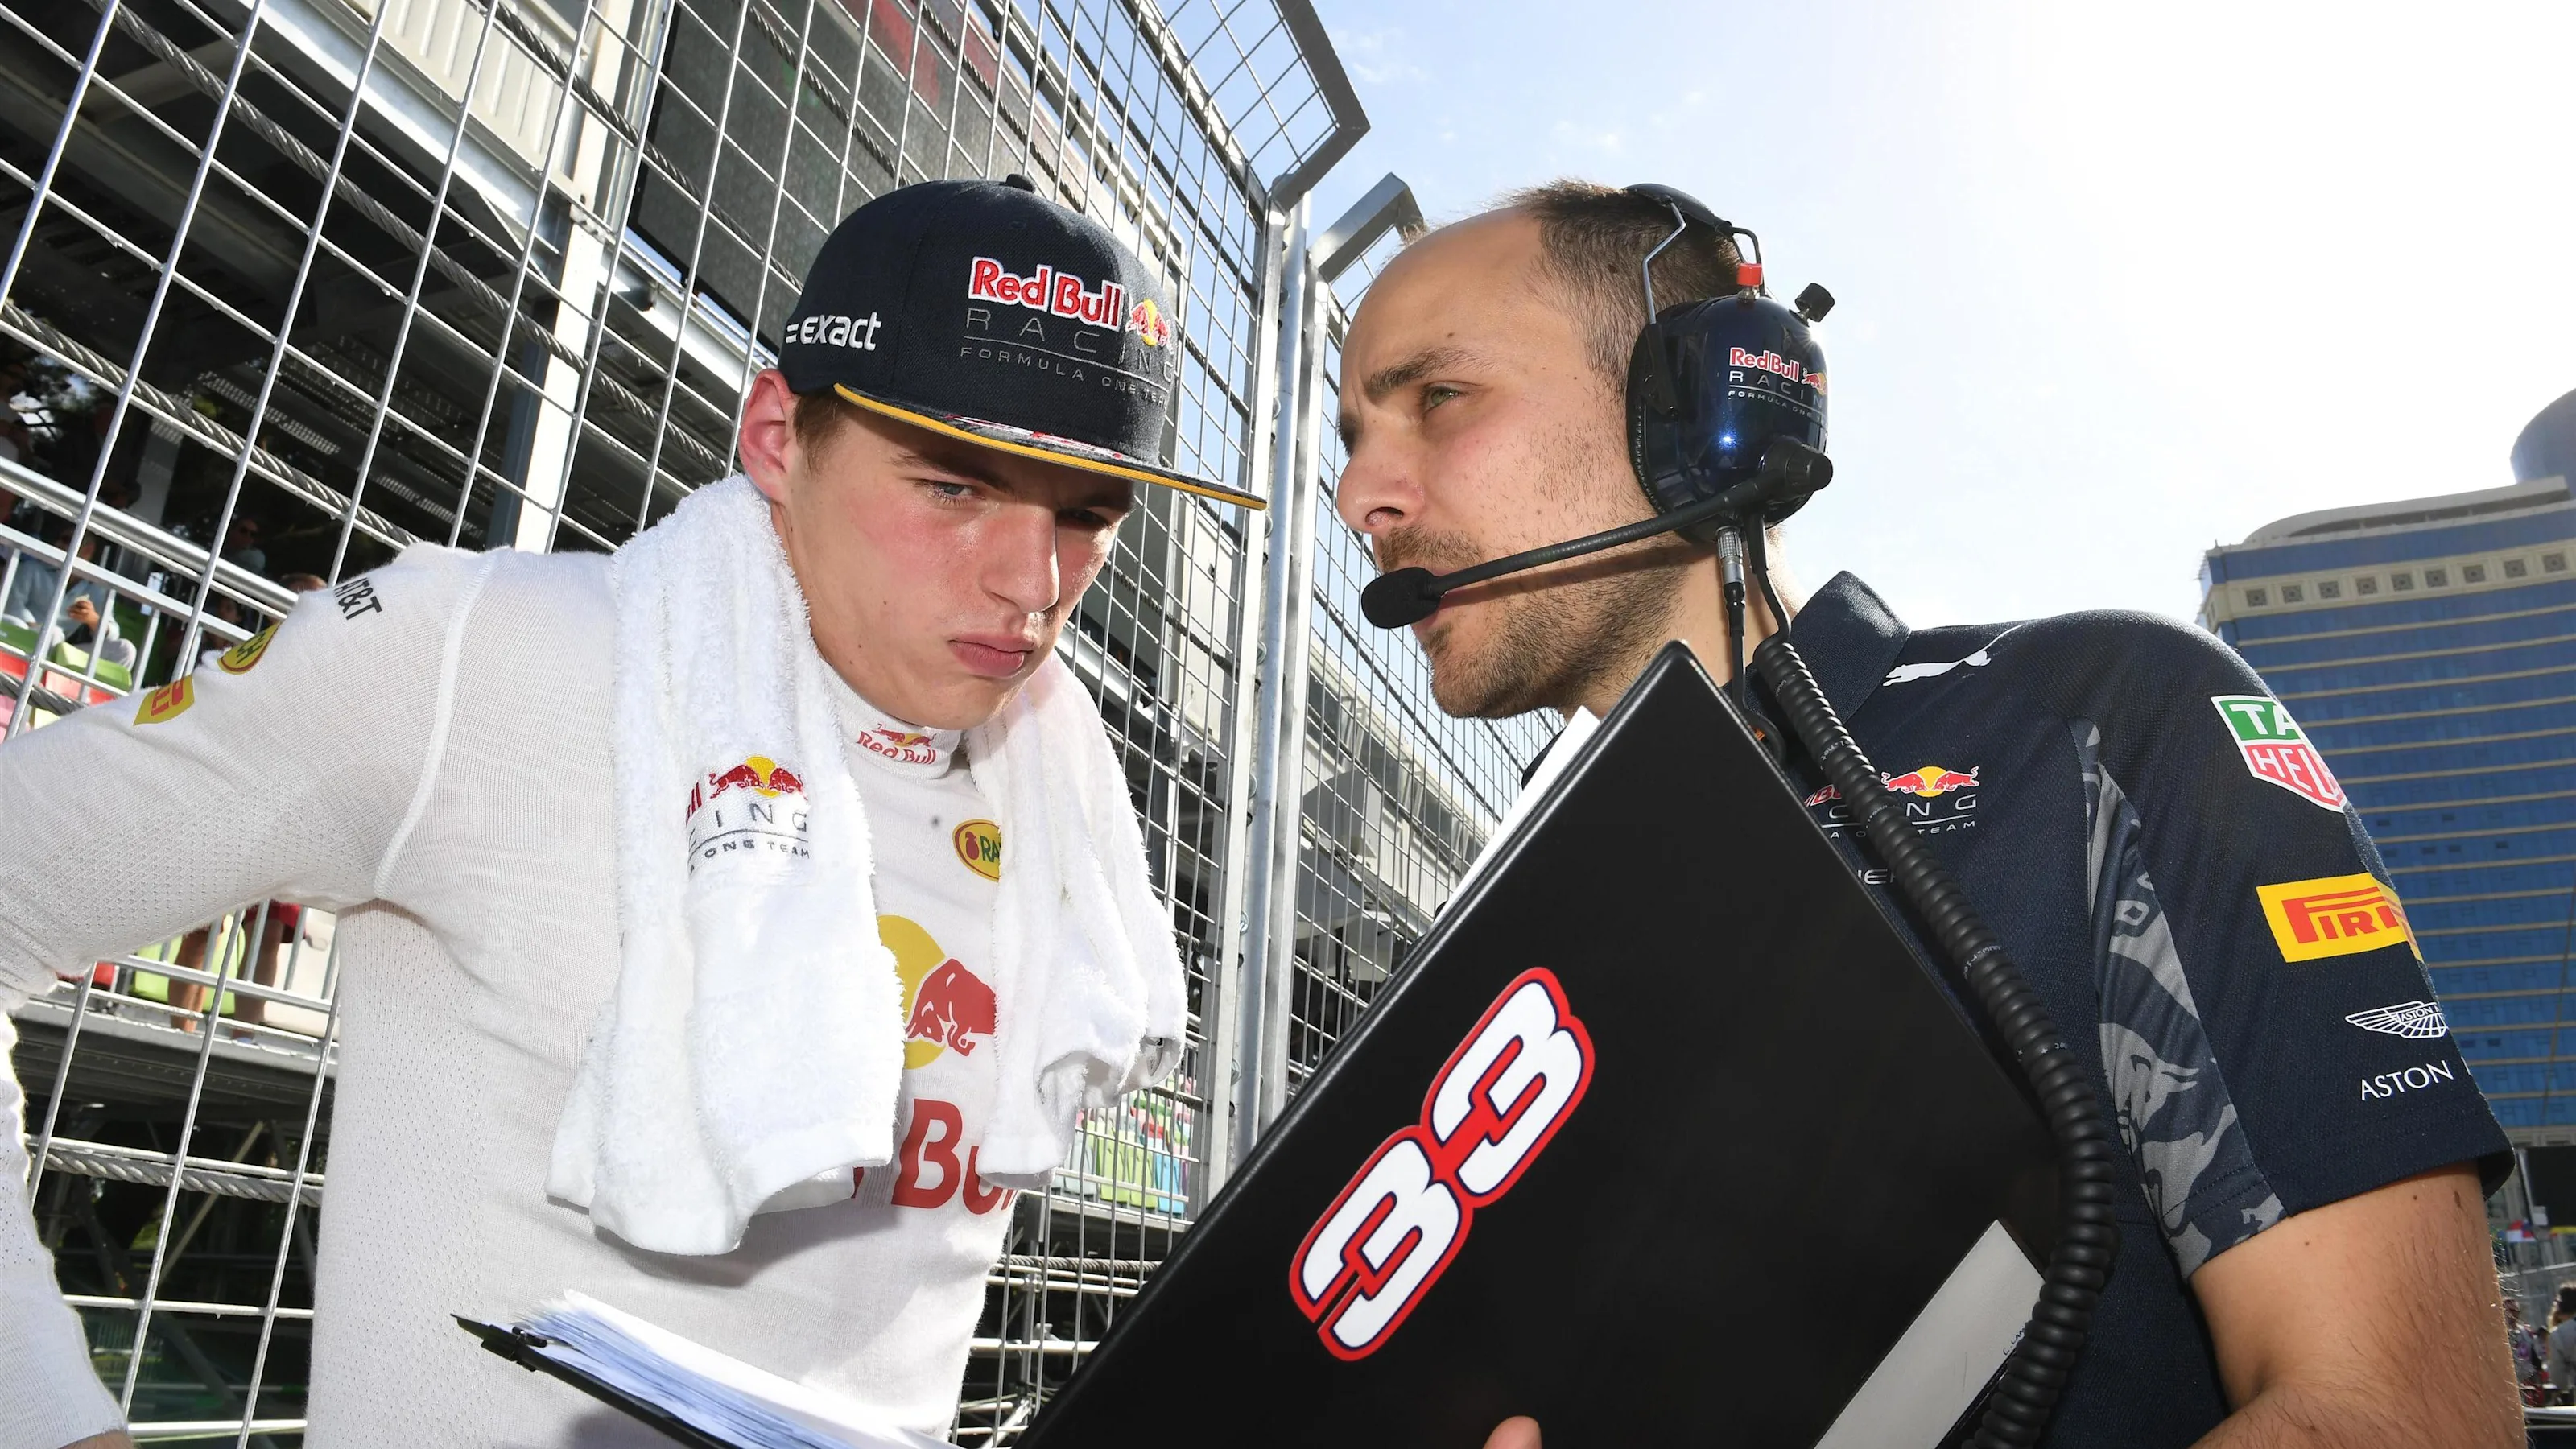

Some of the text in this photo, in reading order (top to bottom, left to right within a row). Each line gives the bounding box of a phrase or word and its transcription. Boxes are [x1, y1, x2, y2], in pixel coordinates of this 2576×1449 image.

[968, 256, 1125, 332] Red Bull
[965, 307, 1179, 383] RACING
[960, 346, 1084, 382] FORMULA
[1100, 375, 1136, 394] ONE
[1729, 347, 1800, 382] Red Bull
[1728, 390, 1787, 408] FORMULA
[333, 577, 382, 621] AT&T
[856, 730, 937, 765] Red Bull
[1917, 820, 1976, 836] TEAM
[767, 840, 810, 860] TEAM
[2401, 1006, 2434, 1022] ASTON
[2361, 1060, 2454, 1101] ASTON
[1289, 966, 1596, 1362] 33
